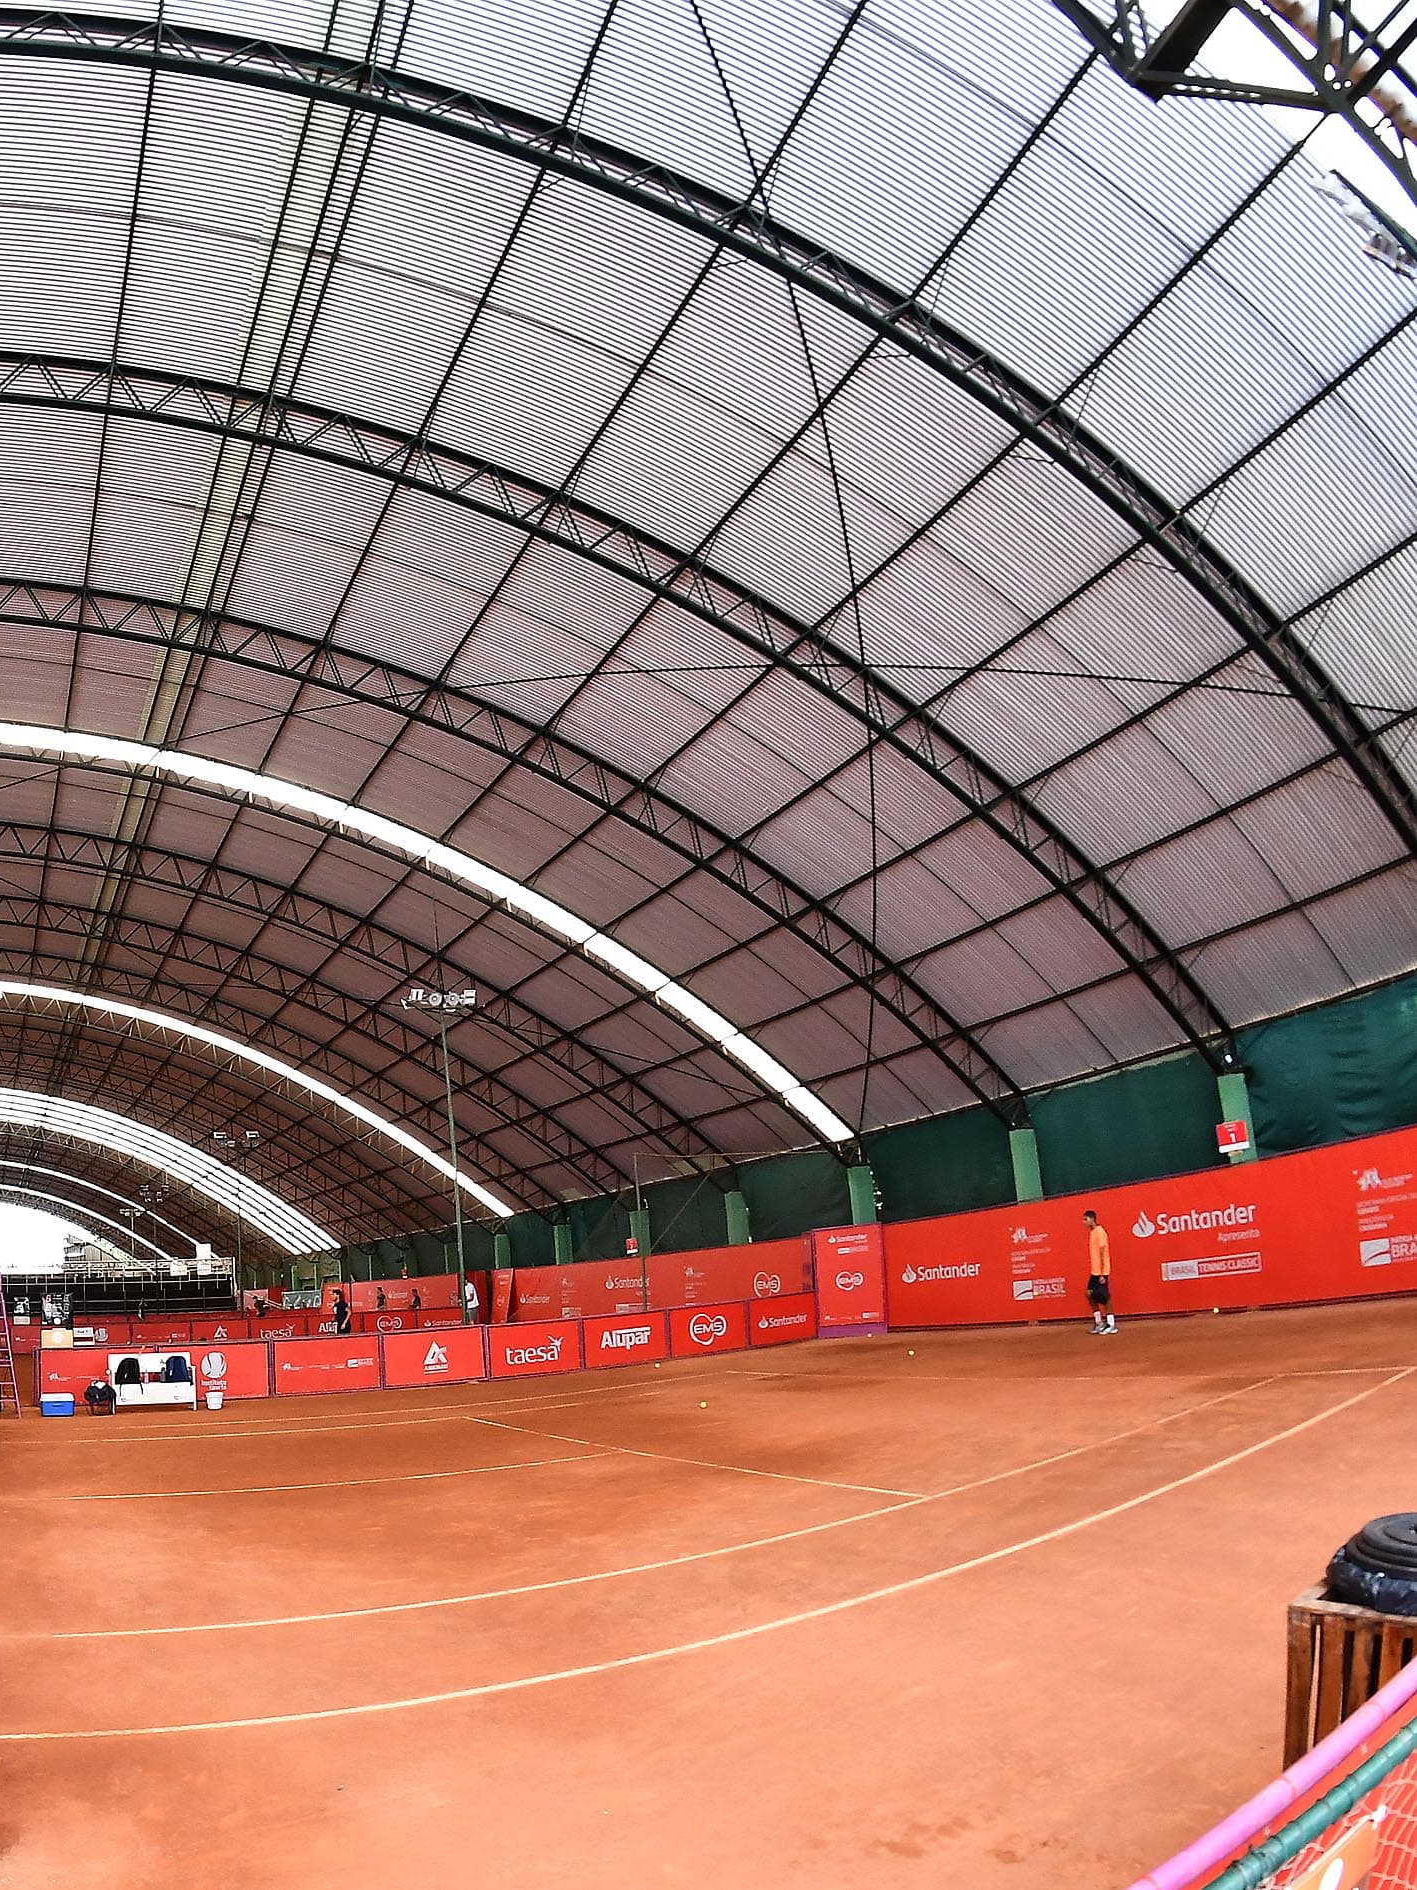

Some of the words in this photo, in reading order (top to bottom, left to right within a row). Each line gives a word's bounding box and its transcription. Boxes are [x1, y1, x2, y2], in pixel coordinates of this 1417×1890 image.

[1157, 1203, 1256, 1236] Santander
[917, 1261, 981, 1282] Santander
[614, 1276, 650, 1289] Santandr
[693, 1320, 722, 1335] EMS
[768, 1313, 808, 1328] Santander
[260, 1326, 293, 1339] taesa
[600, 1327, 651, 1350] Alupar
[505, 1345, 559, 1365] taesa
